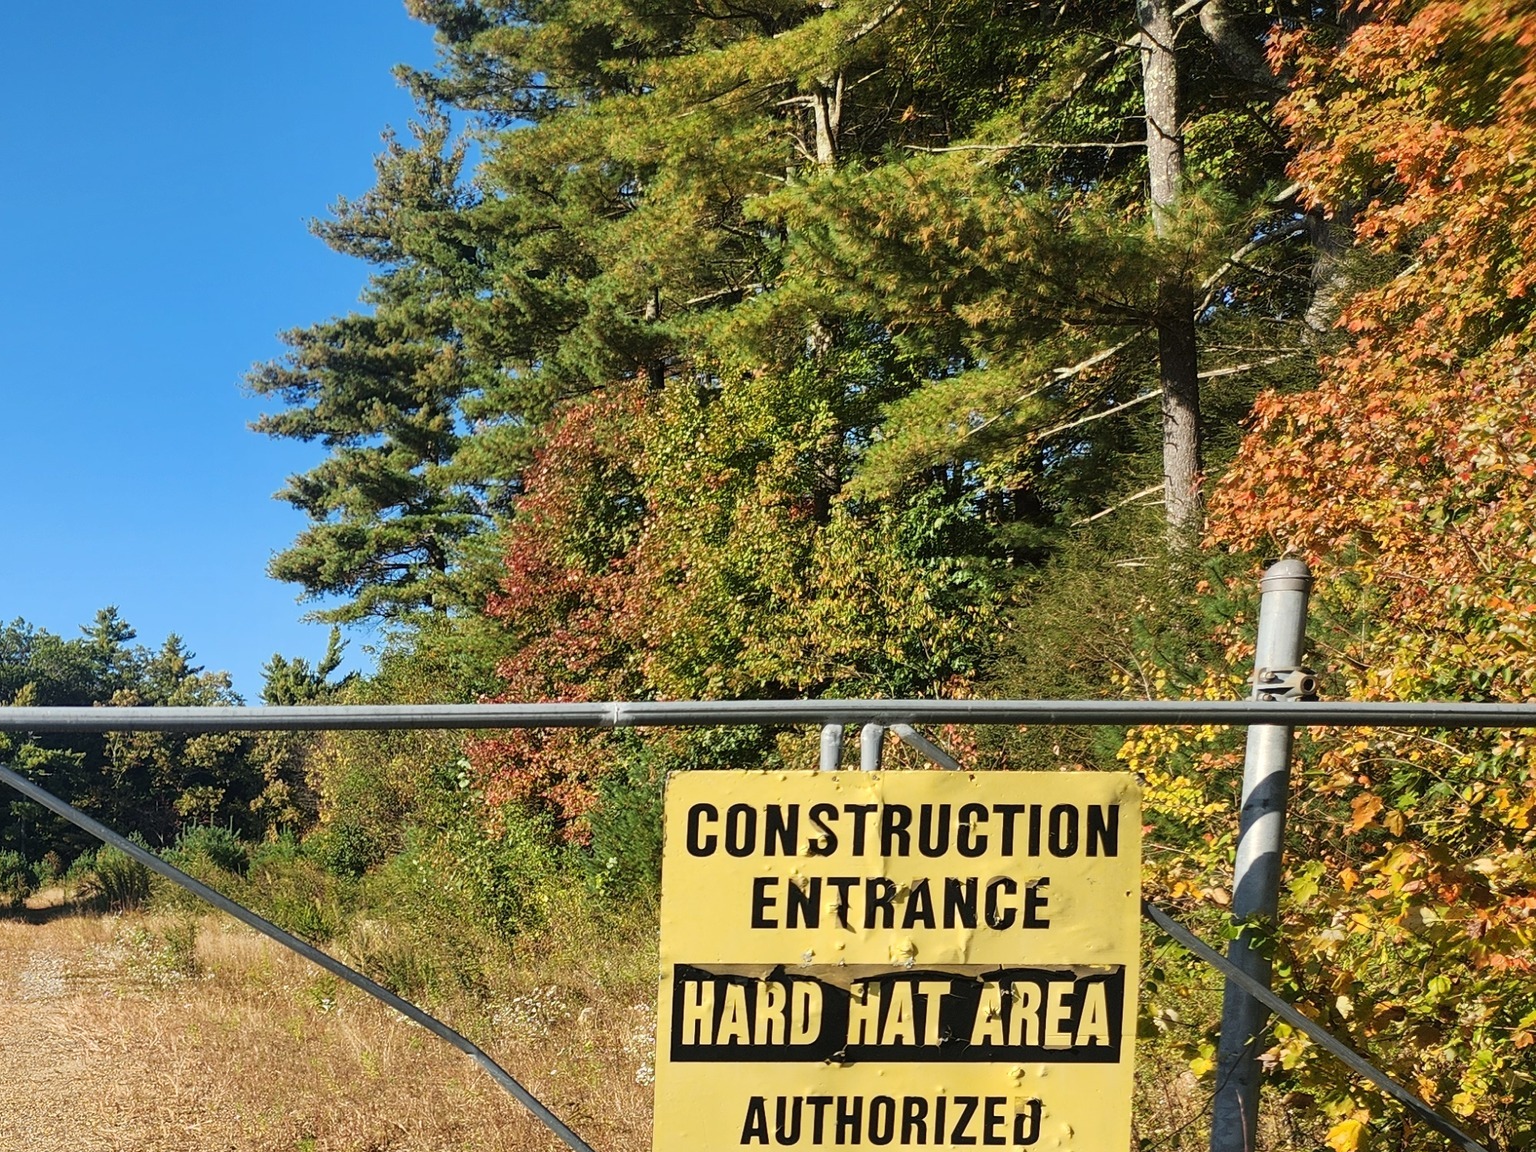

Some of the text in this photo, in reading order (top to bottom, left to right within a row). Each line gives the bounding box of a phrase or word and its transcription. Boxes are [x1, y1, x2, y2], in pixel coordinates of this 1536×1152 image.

[686, 803, 1119, 858] CONSTRUCTION
[751, 877, 1050, 930] ENTRANCE
[680, 980, 1110, 1048] HARD HAT AREA
[740, 1095, 1042, 1146] AUTHORIZED
